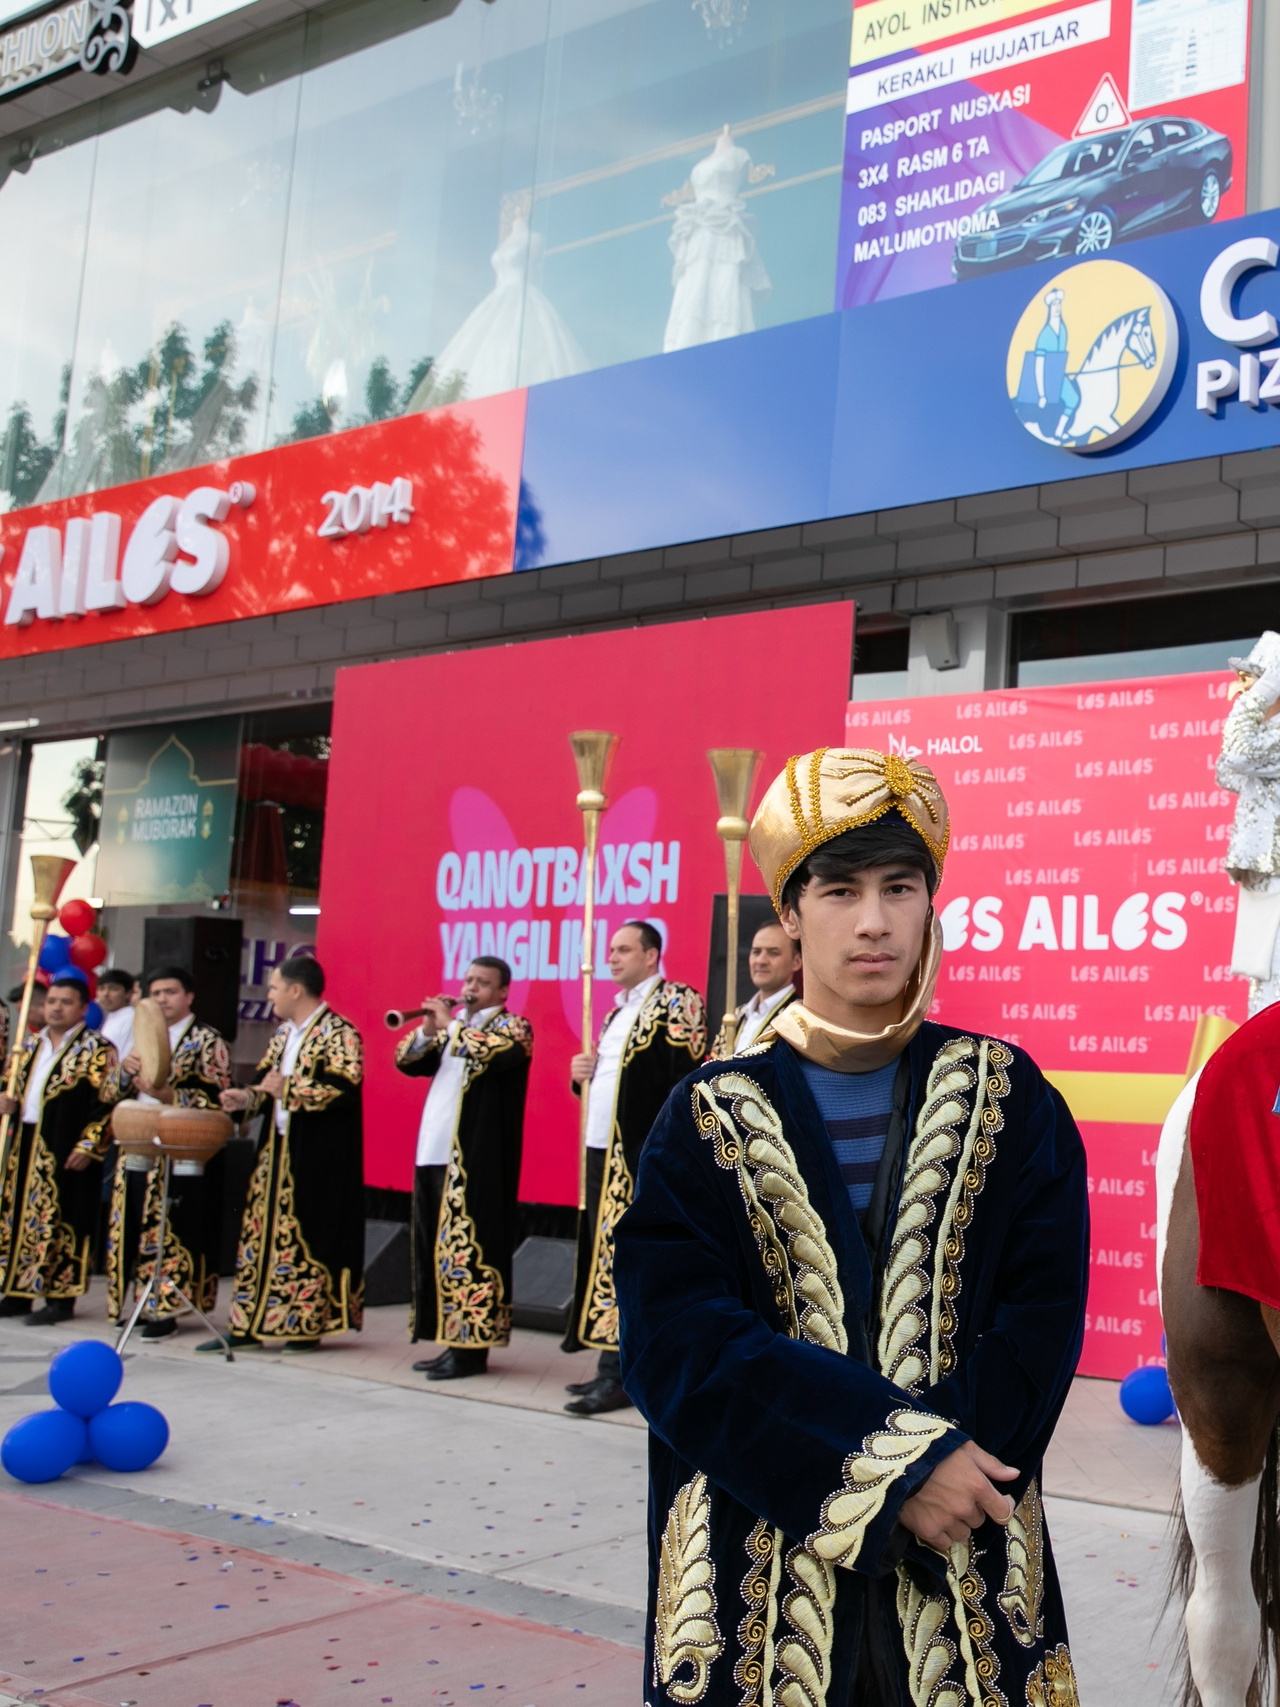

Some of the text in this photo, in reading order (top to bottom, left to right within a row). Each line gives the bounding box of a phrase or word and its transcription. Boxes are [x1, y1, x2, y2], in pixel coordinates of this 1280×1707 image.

[864, 12, 911, 44] AYOL
[877, 20, 1080, 97] KERAKLI HUJJATLAR
[860, 83, 1031, 151] PASPORT NUSXASI
[857, 135, 991, 189] 3X4 RASM 6 TA
[857, 169, 1005, 227] 083 SHAKLIDAGI
[317, 476, 415, 540] 2014
[927, 735, 983, 756] HALOL
[131, 816, 197, 841] MUBORAK
[133, 793, 199, 820] RAMAZON
[436, 840, 680, 910] QANOTBAXSH
